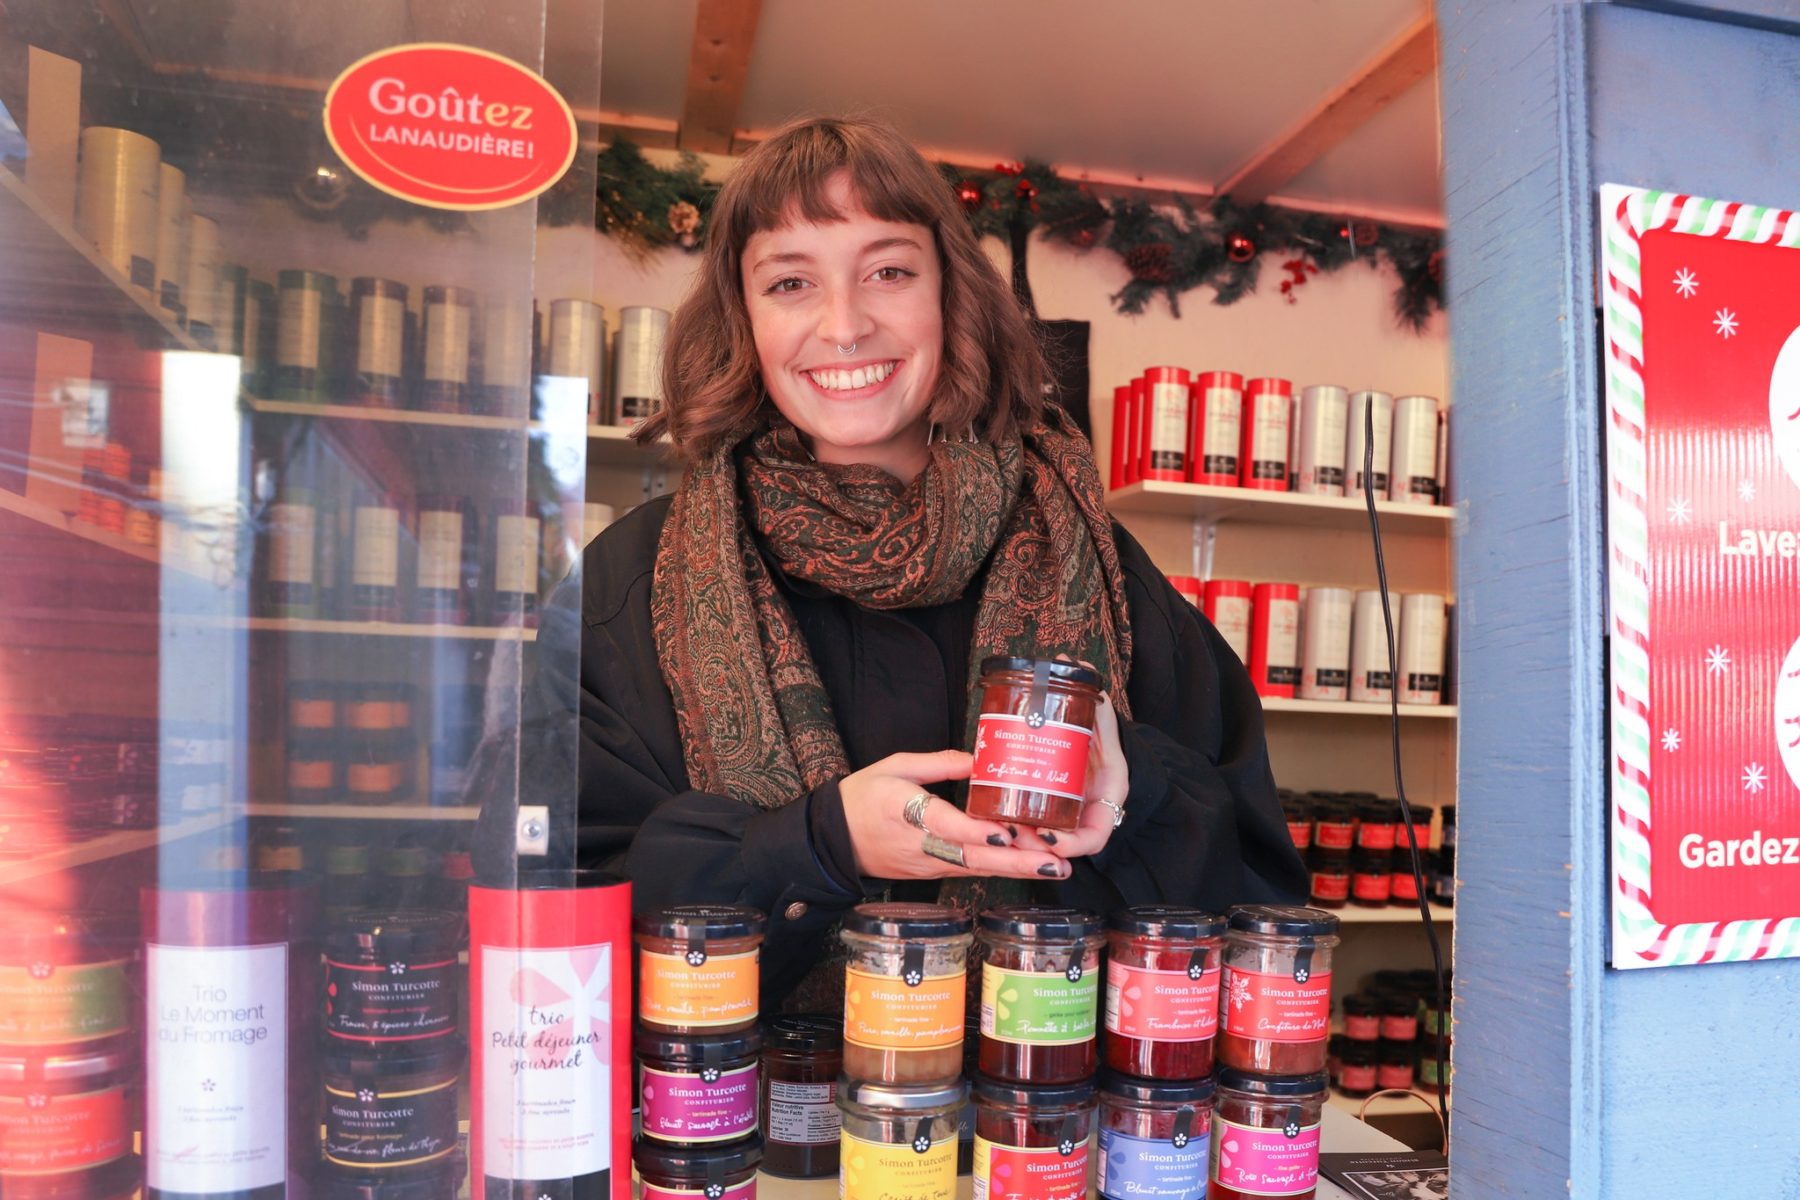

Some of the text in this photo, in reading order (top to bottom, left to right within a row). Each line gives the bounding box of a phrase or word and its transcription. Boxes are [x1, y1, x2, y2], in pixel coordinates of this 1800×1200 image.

[368, 77, 534, 130] Goûtez
[369, 123, 534, 159] LANAUDIÈRE!
[1719, 520, 1800, 558] Lave
[994, 729, 1072, 750] Simon Turcotte
[1679, 830, 1800, 869] Gardez
[692, 970, 736, 981] Turcotte
[352, 979, 440, 992] Simon Turcotte
[1154, 985, 1188, 995] Simon
[192, 984, 228, 1002] Trio
[870, 990, 950, 1001] Simon Turcotte
[1033, 987, 1068, 998] Simon
[1261, 987, 1294, 998] Simon
[160, 1003, 264, 1023] Le Moment
[528, 1005, 564, 1026] trio
[184, 1026, 268, 1046] Fromage
[492, 1028, 602, 1056] Petit déjeuner
[510, 1050, 582, 1076] gourmet
[668, 1083, 747, 1098] Simon Turcotte
[684, 1096, 734, 1106] CONFITURIER
[362, 1106, 414, 1119] Turcotte
[1252, 1142, 1285, 1152] Simon
[1138, 1152, 1173, 1162] Simon
[1266, 1152, 1309, 1160] CONFITURIER
[879, 1158, 914, 1168] Simon
[1026, 1163, 1060, 1173] Simon
